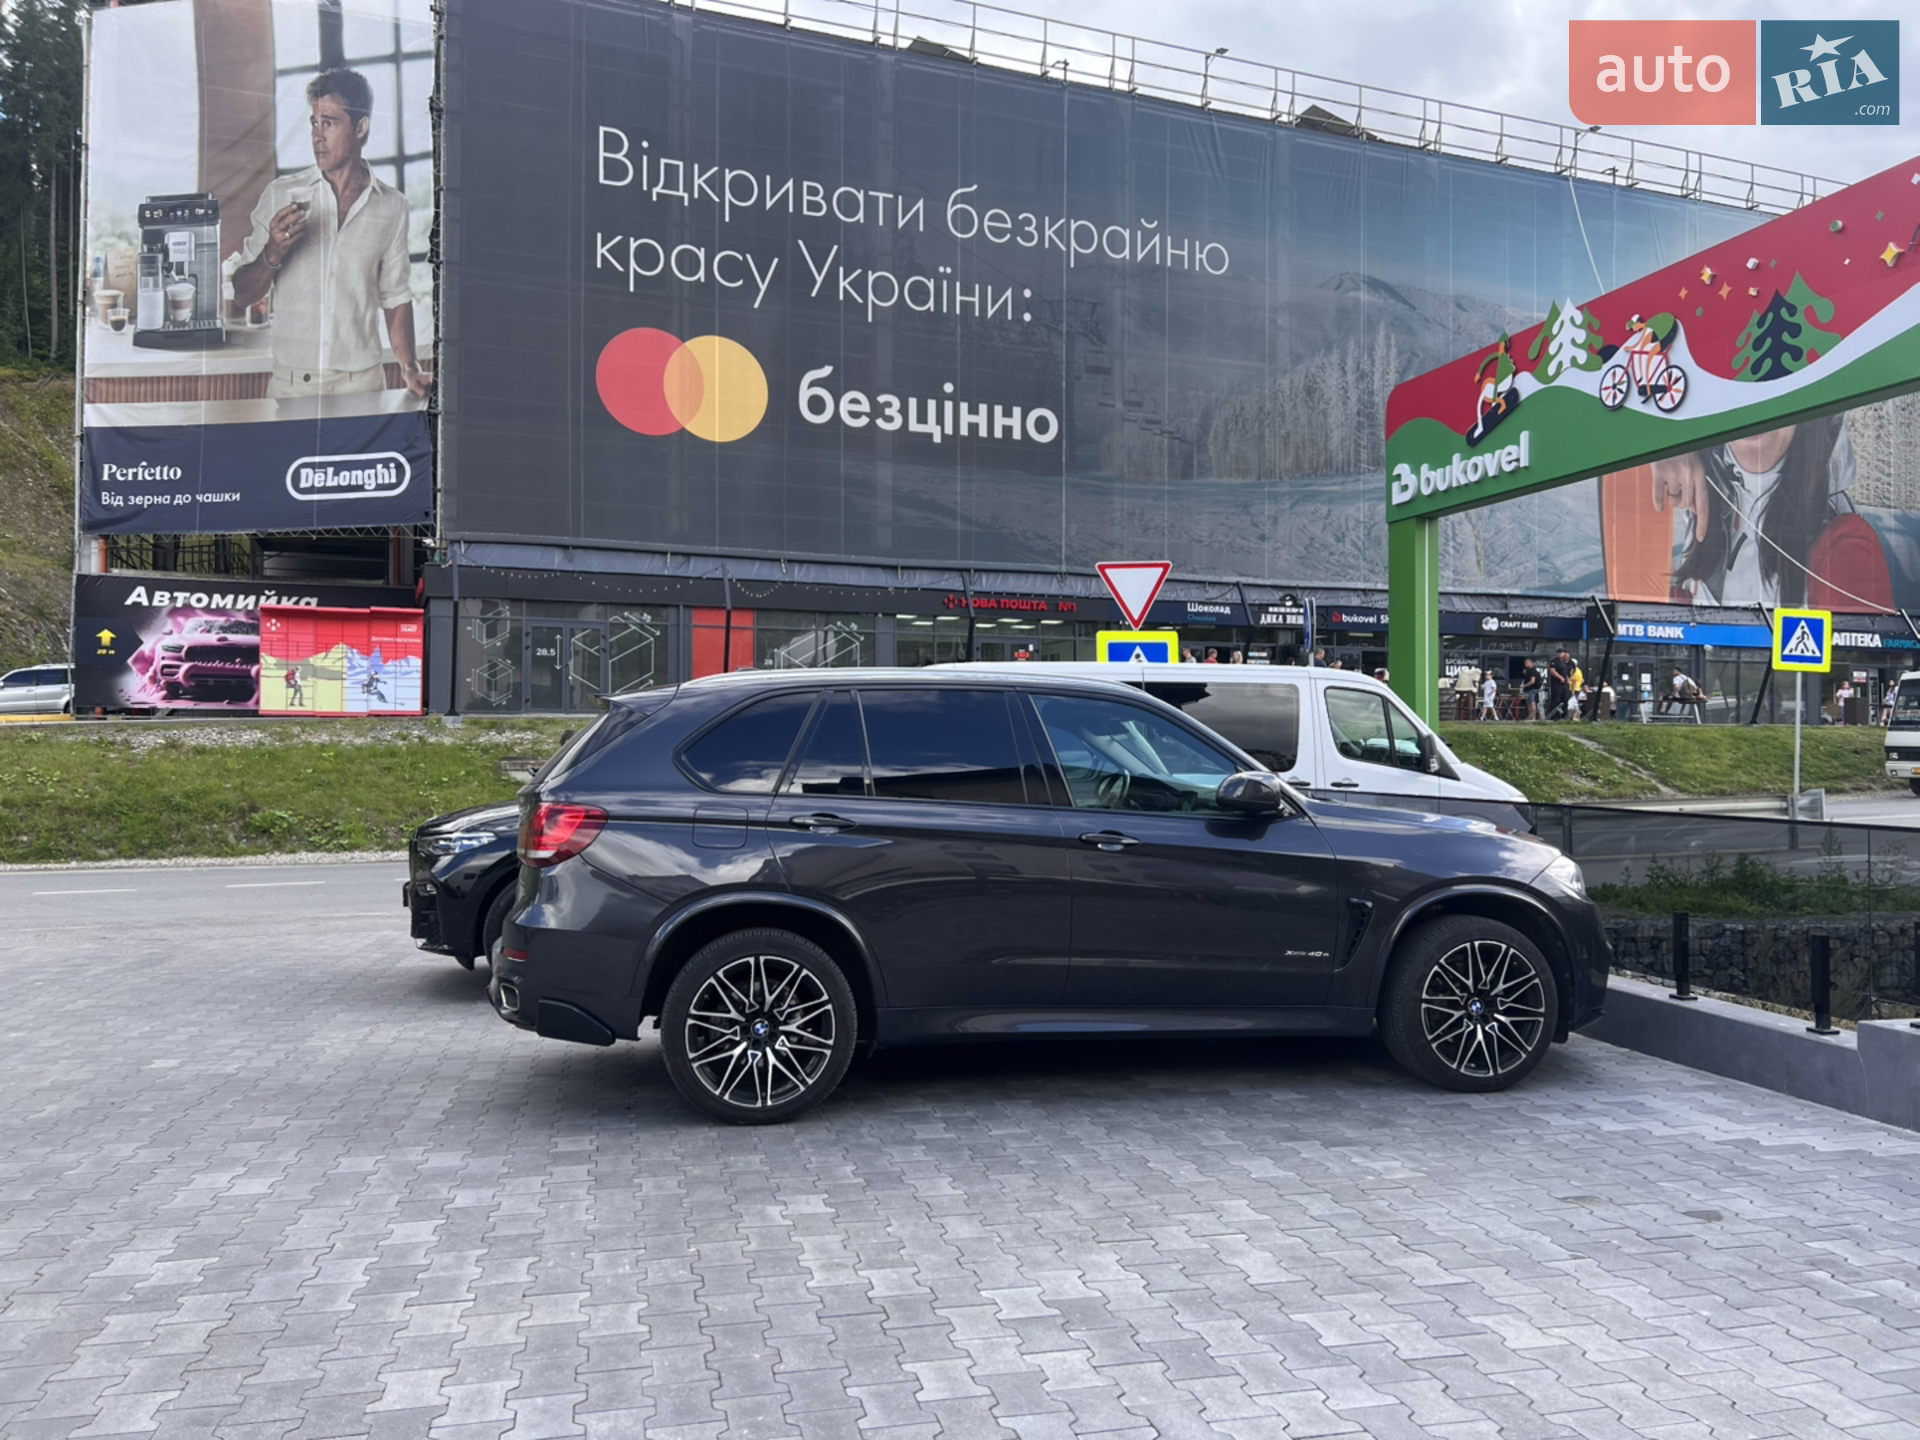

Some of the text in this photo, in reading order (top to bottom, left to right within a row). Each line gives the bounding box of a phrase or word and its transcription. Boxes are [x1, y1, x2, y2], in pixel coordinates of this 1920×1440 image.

[598, 125, 1230, 276] Відкривати безкрайню
[596, 232, 1033, 323] красу України:
[797, 364, 1060, 444] безцінно
[101, 460, 183, 481] Perfetto
[1419, 429, 1531, 497] bukovel
[101, 491, 241, 509] Від зерна до чашки
[1000, 598, 1048, 611] ПОШТА
[1187, 602, 1231, 615] Шоколад
[1341, 612, 1377, 624] bukovel
[1500, 620, 1539, 629] CRAFT BEER
[1646, 625, 1685, 639] BANK
[1831, 631, 1882, 648] АПТЕКА
